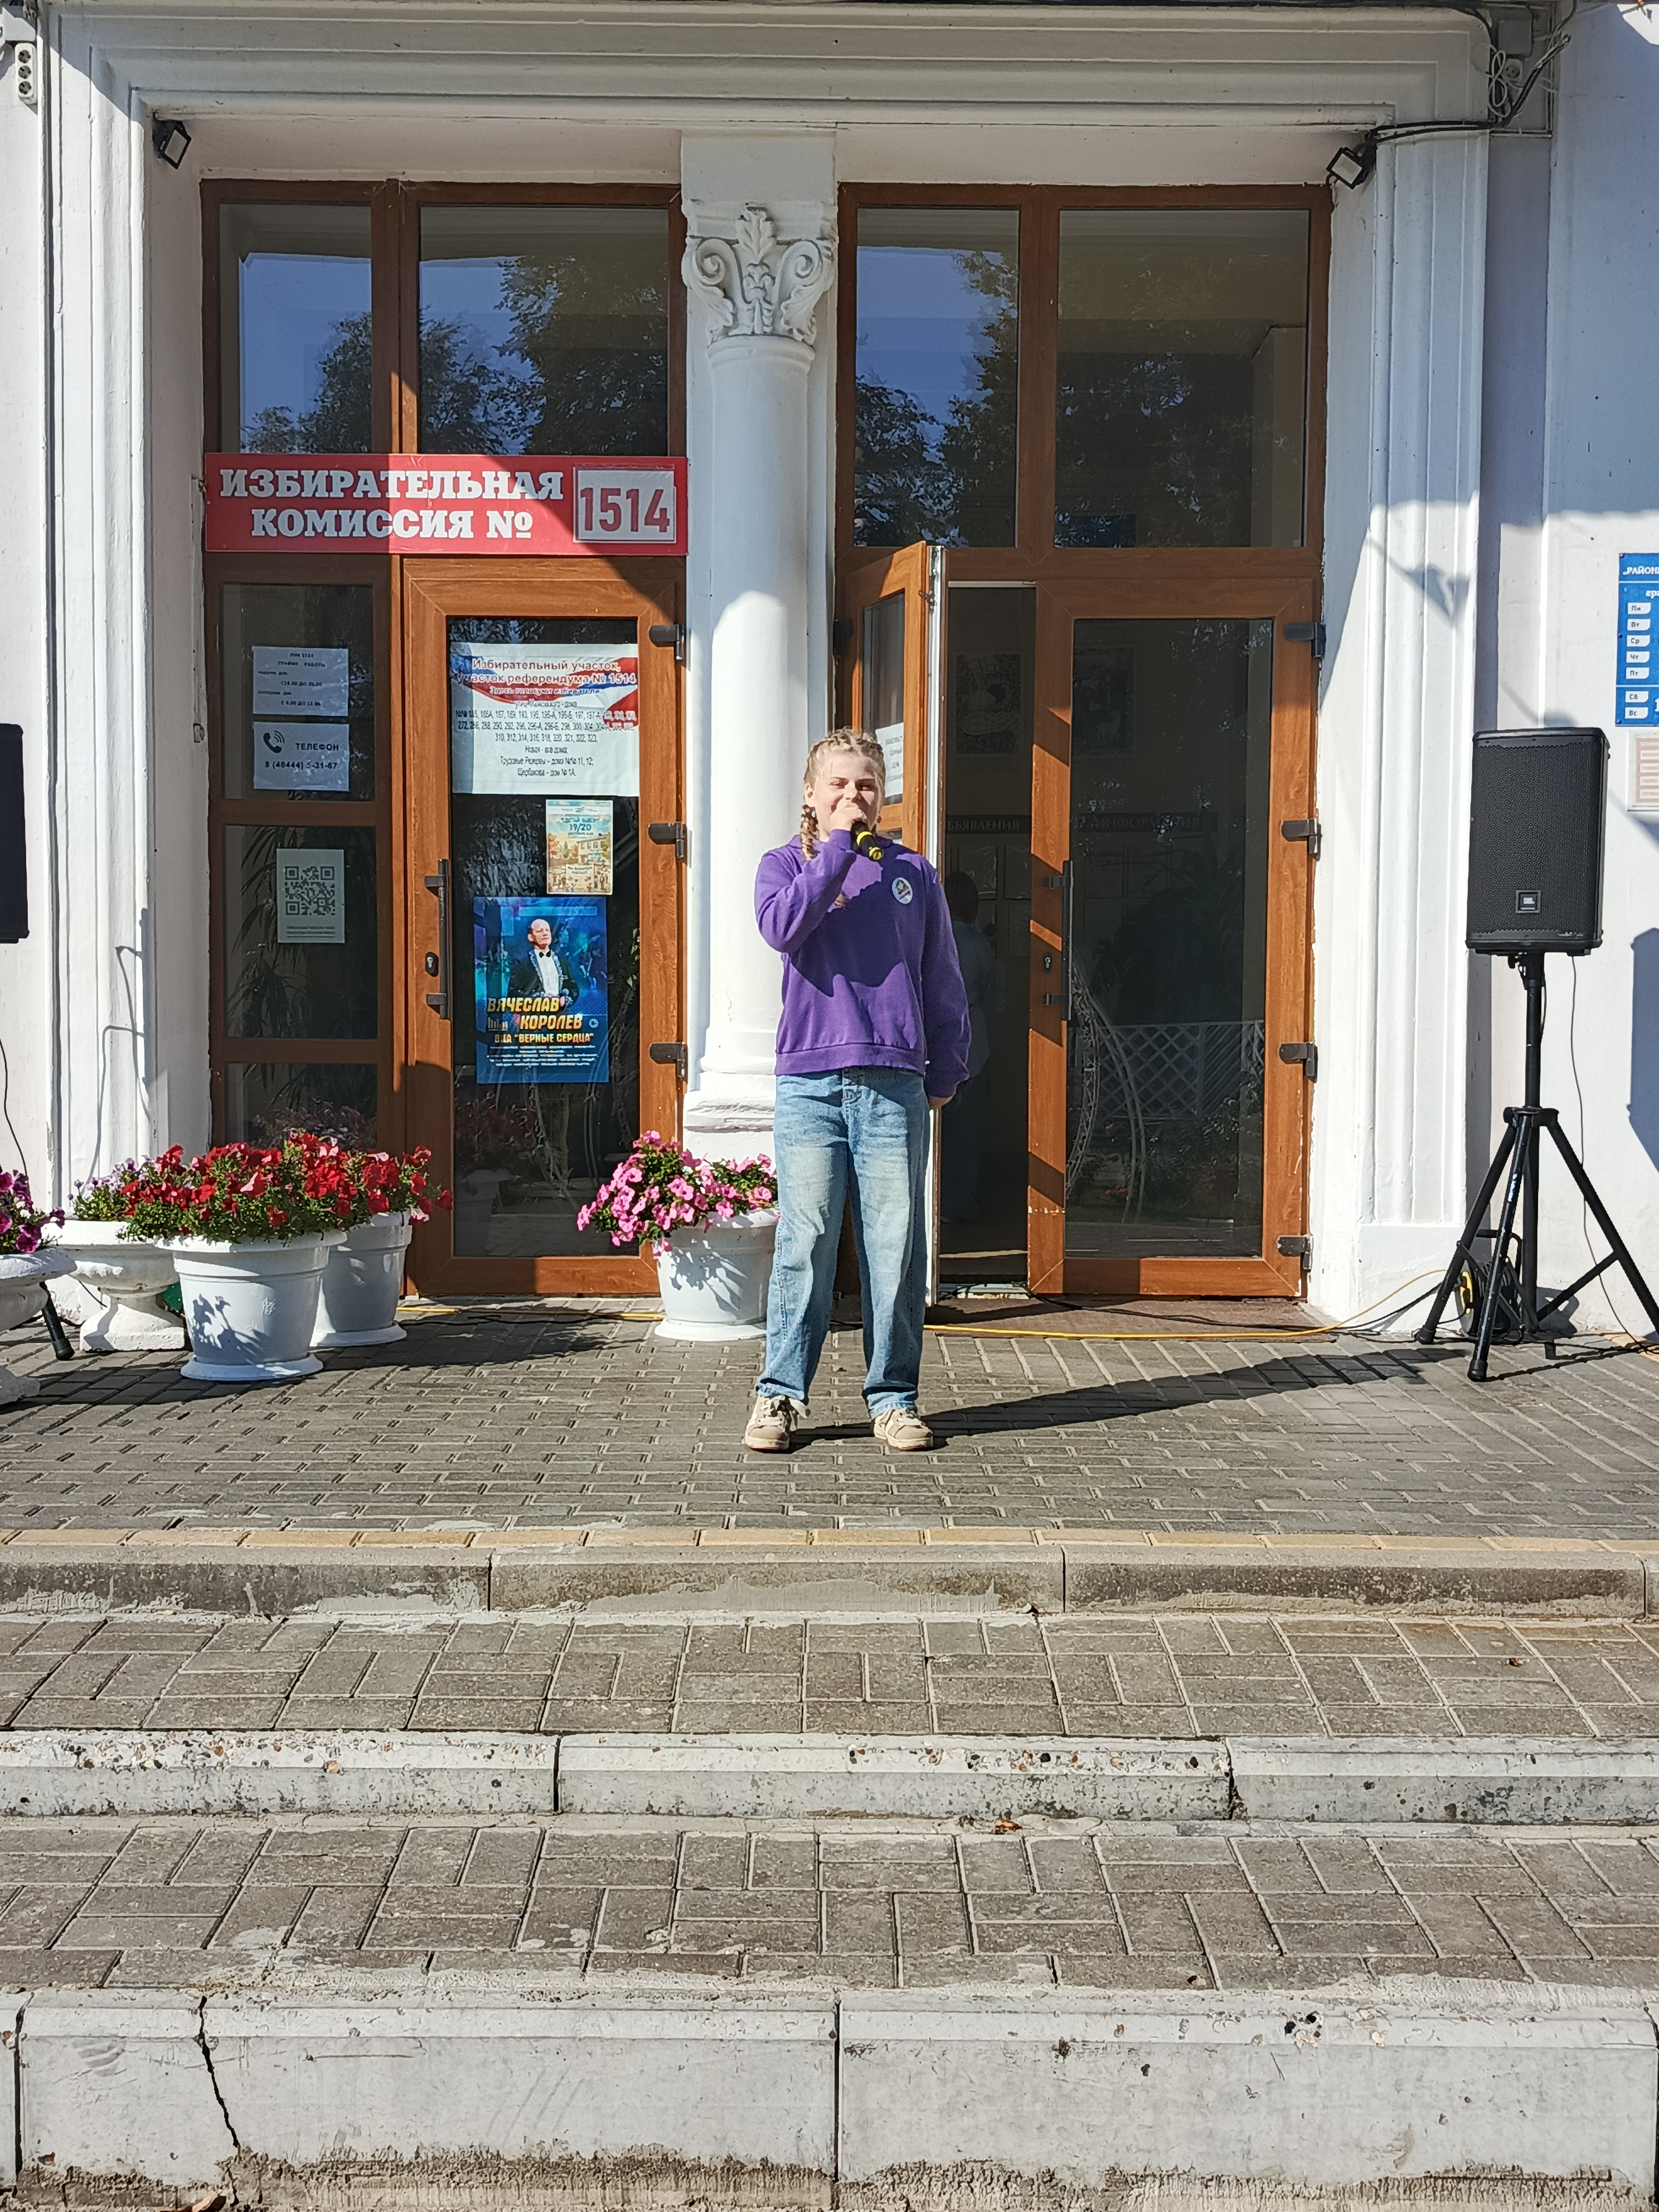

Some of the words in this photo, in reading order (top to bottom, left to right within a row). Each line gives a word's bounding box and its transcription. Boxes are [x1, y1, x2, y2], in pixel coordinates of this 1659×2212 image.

[220, 469, 563, 499] ИЗБИРАТЕЛЬНАЯ
[578, 487, 670, 533] 1514
[251, 508, 474, 539] КОМИССИЯ
[487, 510, 533, 539] №
[473, 660, 567, 671] Избирательный
[508, 673, 589, 686] референдума
[609, 673, 636, 683] 1514
[570, 823, 591, 833] 19/20
[1094, 817, 1199, 828] ИНФОРМЦИЯ
[487, 997, 560, 1012] ВЯЧЕСЛАВ
[520, 1015, 583, 1031] КОРОЛЕВ
